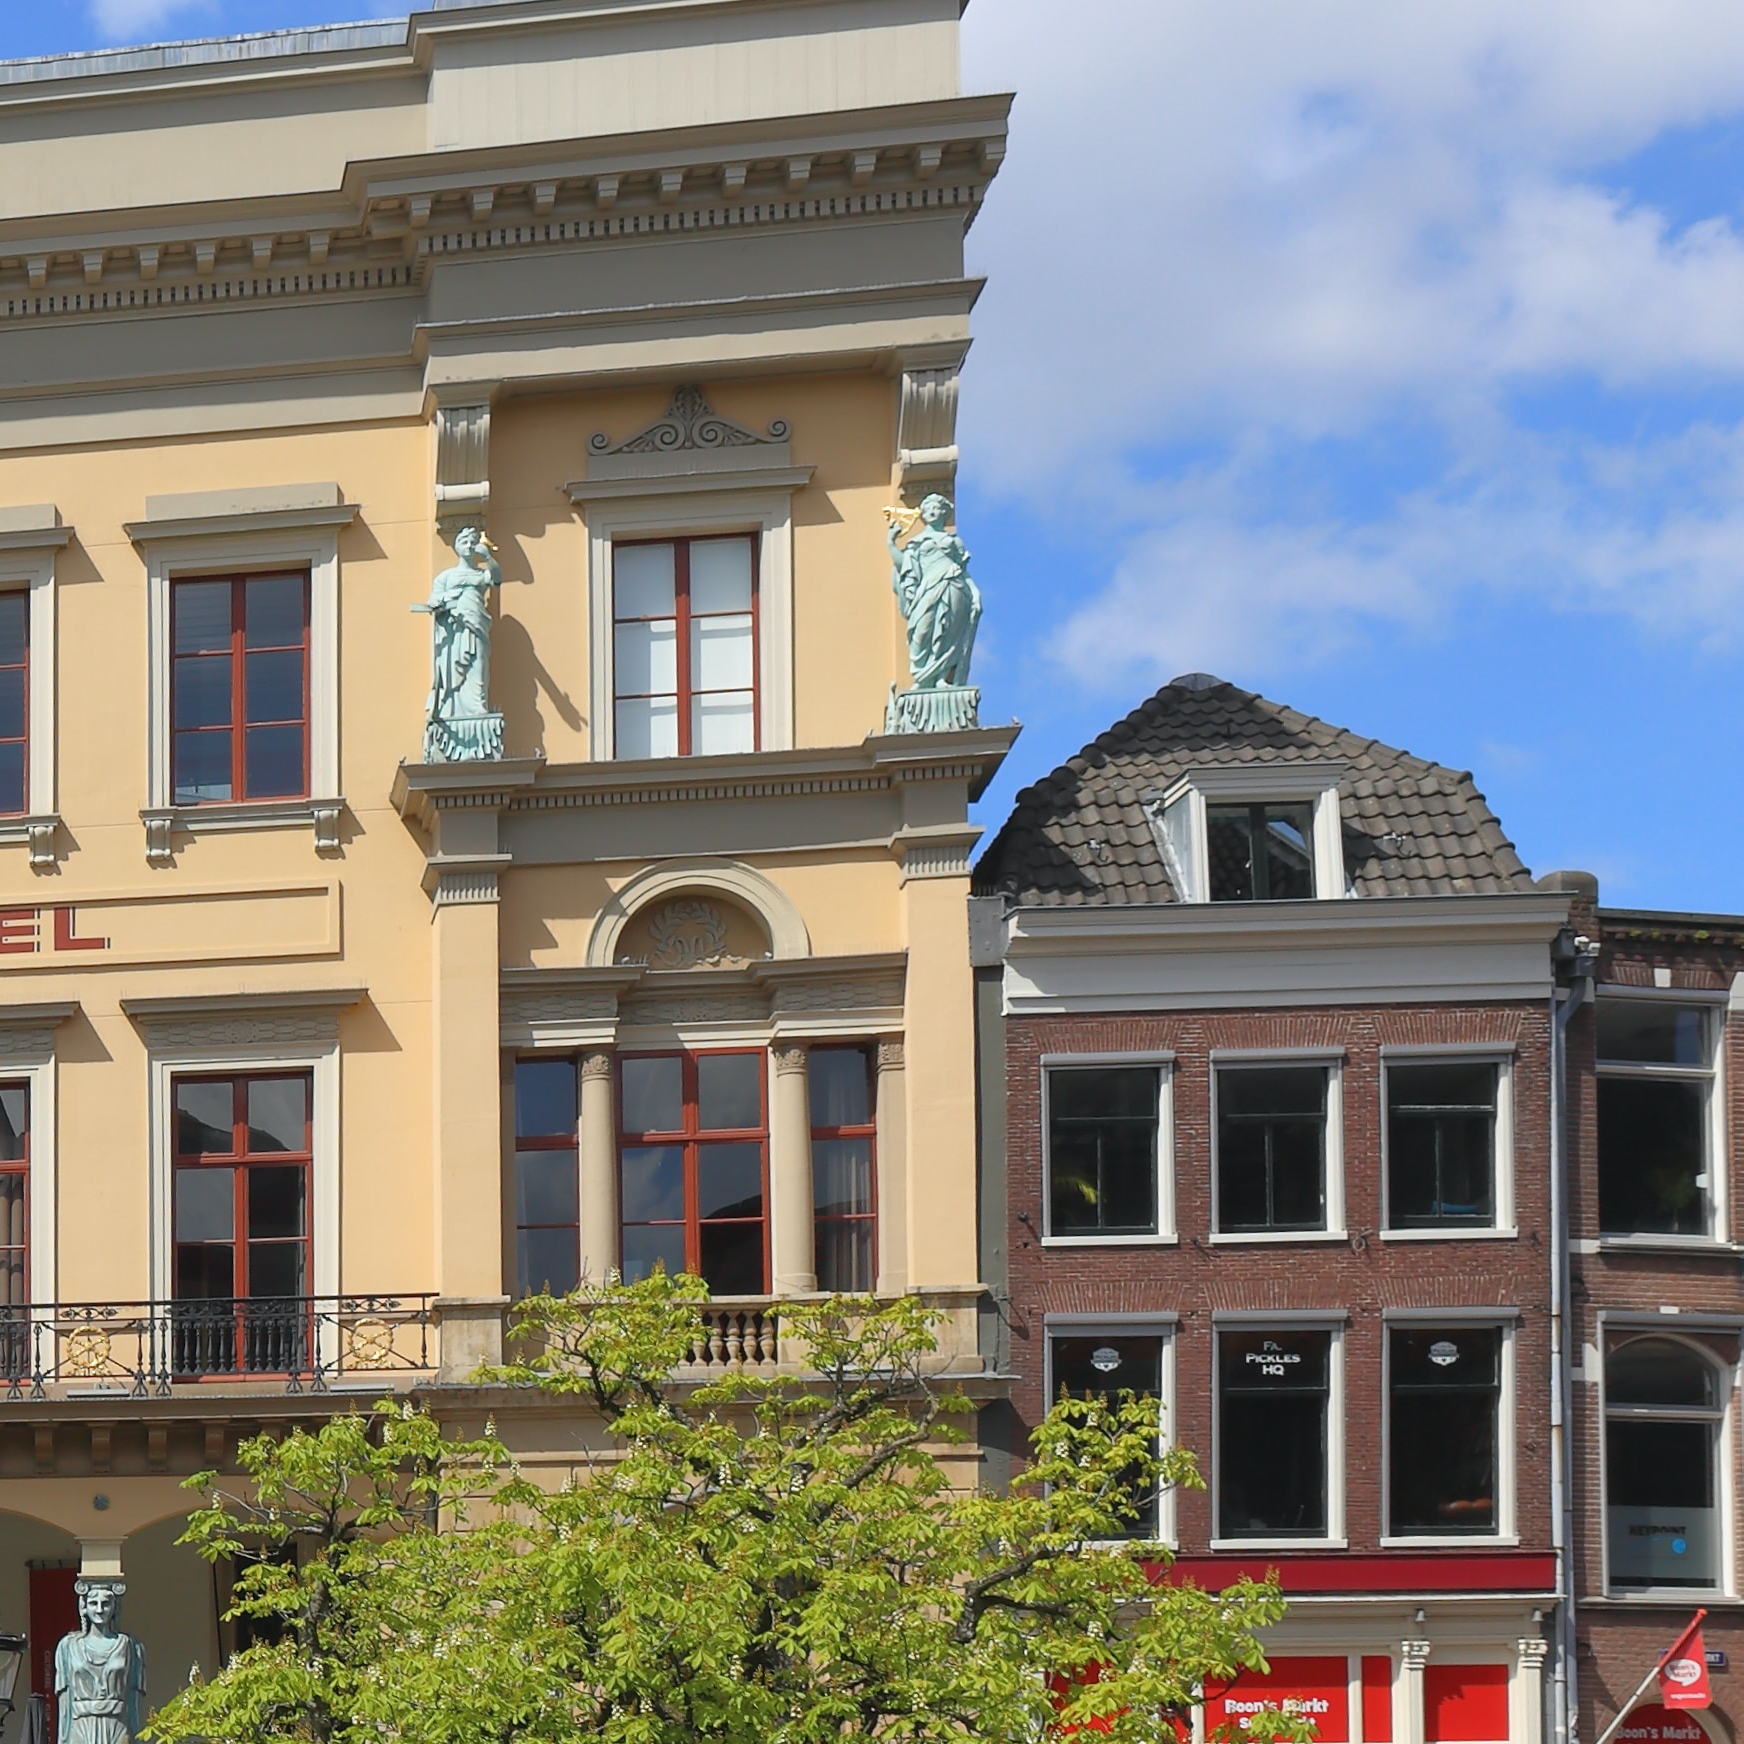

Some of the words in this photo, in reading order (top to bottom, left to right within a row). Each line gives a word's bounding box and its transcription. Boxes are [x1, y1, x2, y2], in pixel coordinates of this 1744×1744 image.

[1246, 1353, 1300, 1364] PICKLES
[1262, 1364, 1284, 1376] HQ
[1615, 1726, 1658, 1739] Boon's
[1662, 1726, 1702, 1739] Markt
